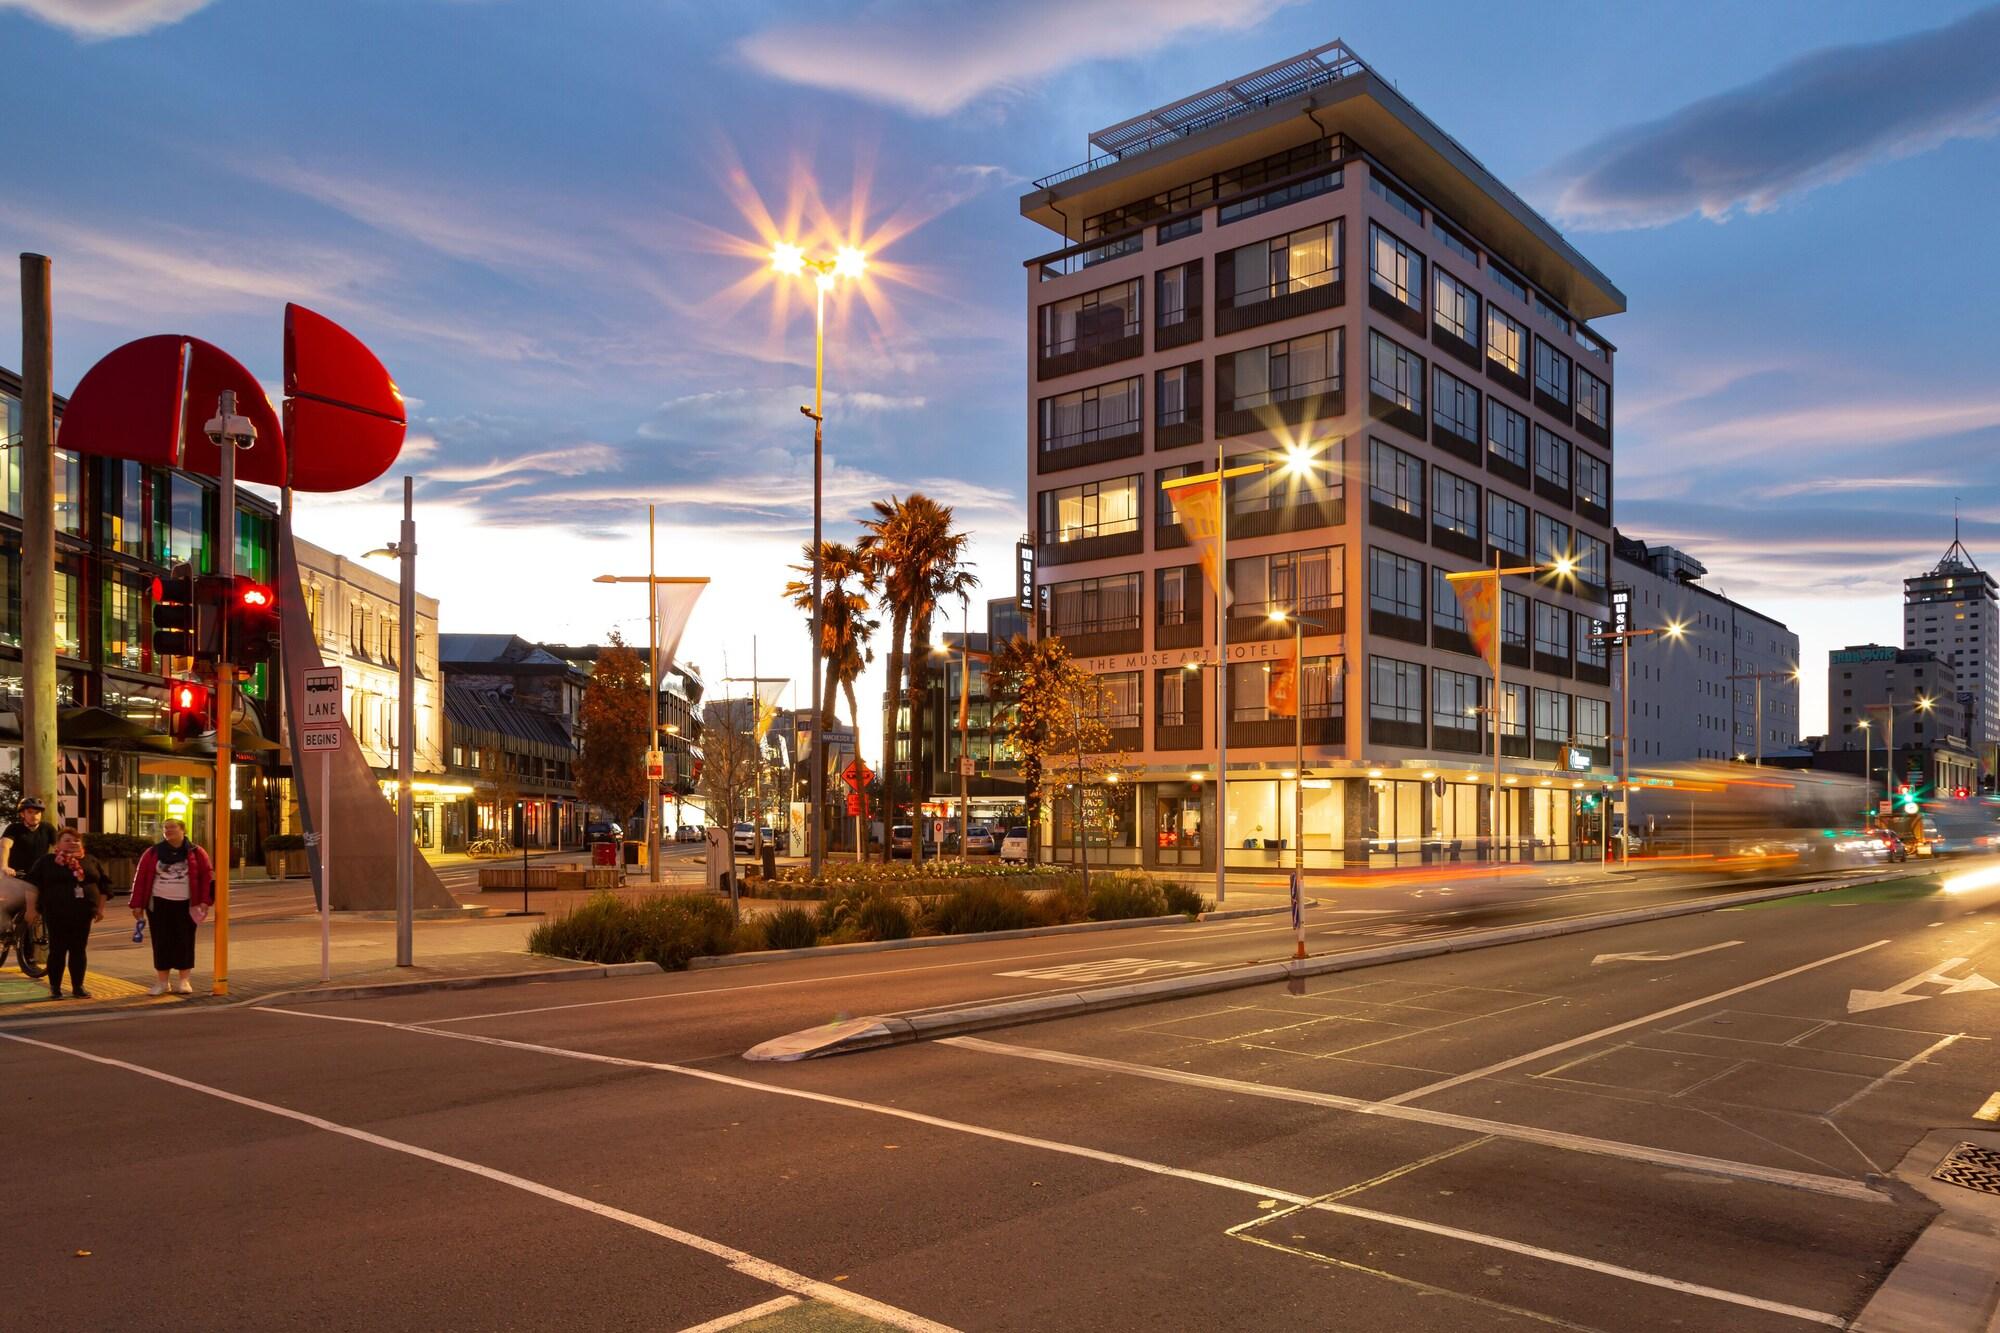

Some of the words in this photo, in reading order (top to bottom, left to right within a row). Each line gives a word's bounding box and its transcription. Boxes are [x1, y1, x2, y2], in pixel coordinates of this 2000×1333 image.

[1021, 548, 1033, 597] muse
[1613, 593, 1628, 634] muse
[1088, 657, 1116, 671] THE
[1126, 653, 1169, 668] MUSE
[1180, 649, 1210, 664] ART
[308, 702, 337, 716] LANE
[306, 733, 338, 746] BEGINS
[1083, 789, 1102, 797] ETAIL
[1082, 799, 1104, 807] PACE
[992, 957, 1213, 982] BUS
